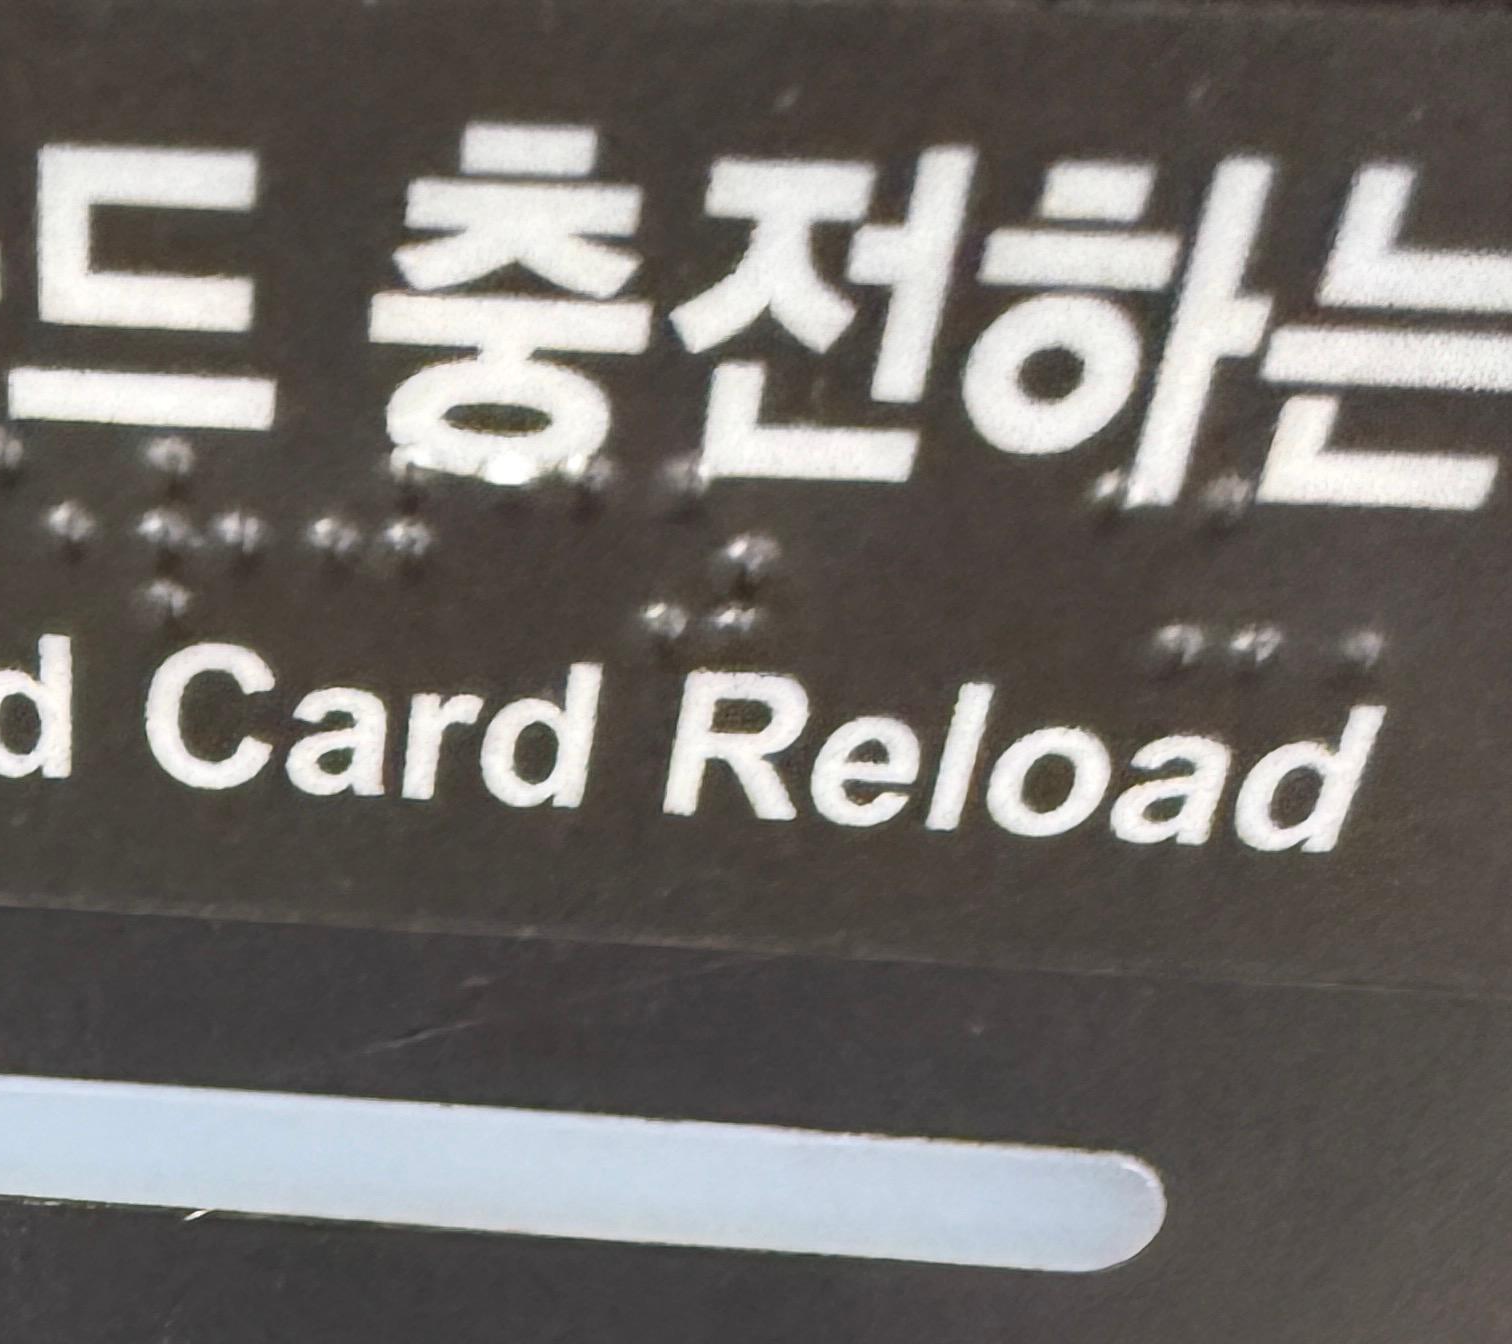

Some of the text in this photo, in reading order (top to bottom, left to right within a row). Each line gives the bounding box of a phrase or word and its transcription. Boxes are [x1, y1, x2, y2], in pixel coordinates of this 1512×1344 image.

[369, 122, 1512, 511] 충전하는
[146, 641, 603, 809] Card
[662, 668, 1386, 853] Reload
